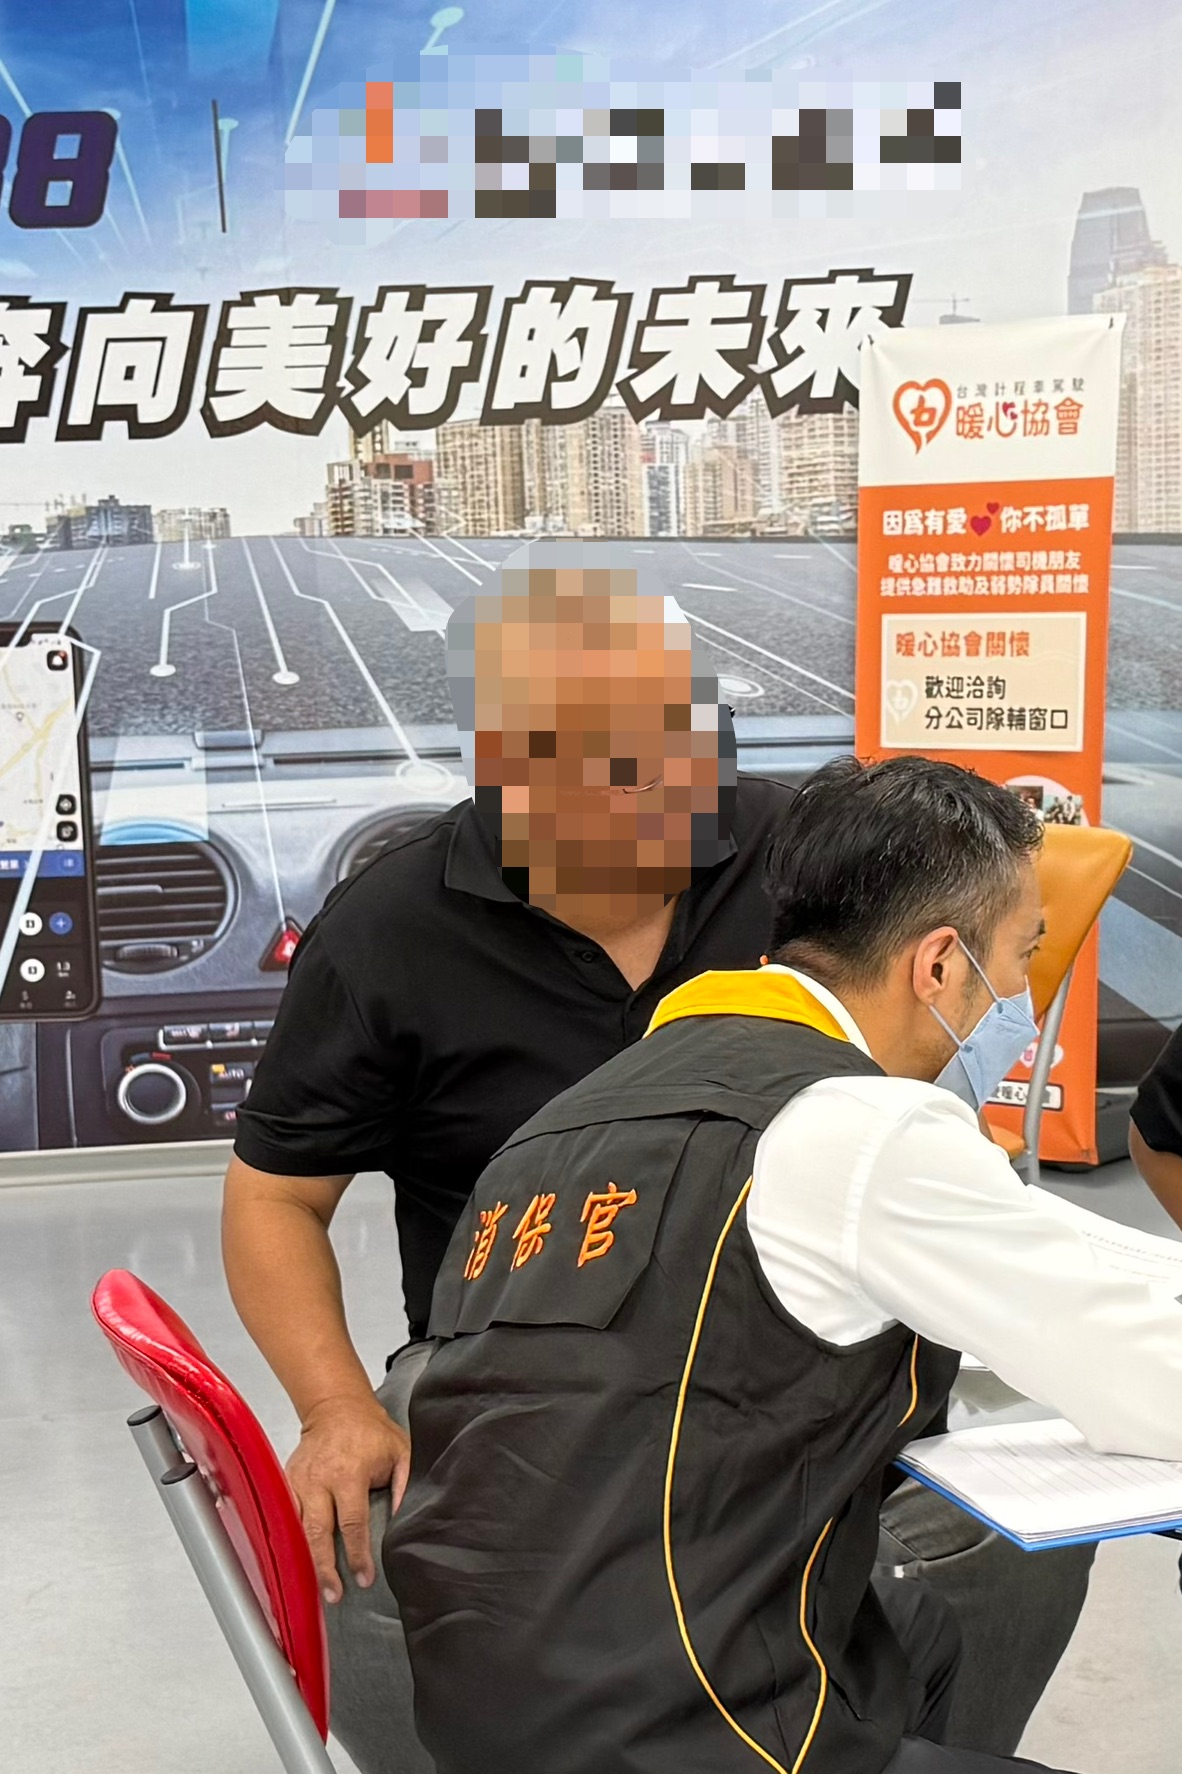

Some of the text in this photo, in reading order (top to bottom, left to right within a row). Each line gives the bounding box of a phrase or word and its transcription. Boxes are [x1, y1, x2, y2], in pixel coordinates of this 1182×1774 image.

[0, 110, 118, 229] 8
[956, 377, 1085, 399] 台灣計程車駕駛
[955, 396, 1084, 440] 暖心協會
[1000, 503, 1090, 533] 你不孤單
[895, 630, 1031, 658] 暖心協會關懷
[924, 674, 1007, 700] 歡迎洽詢
[924, 705, 1069, 732] 分公司隊輔窗口
[463, 1181, 638, 1281] 消保官
